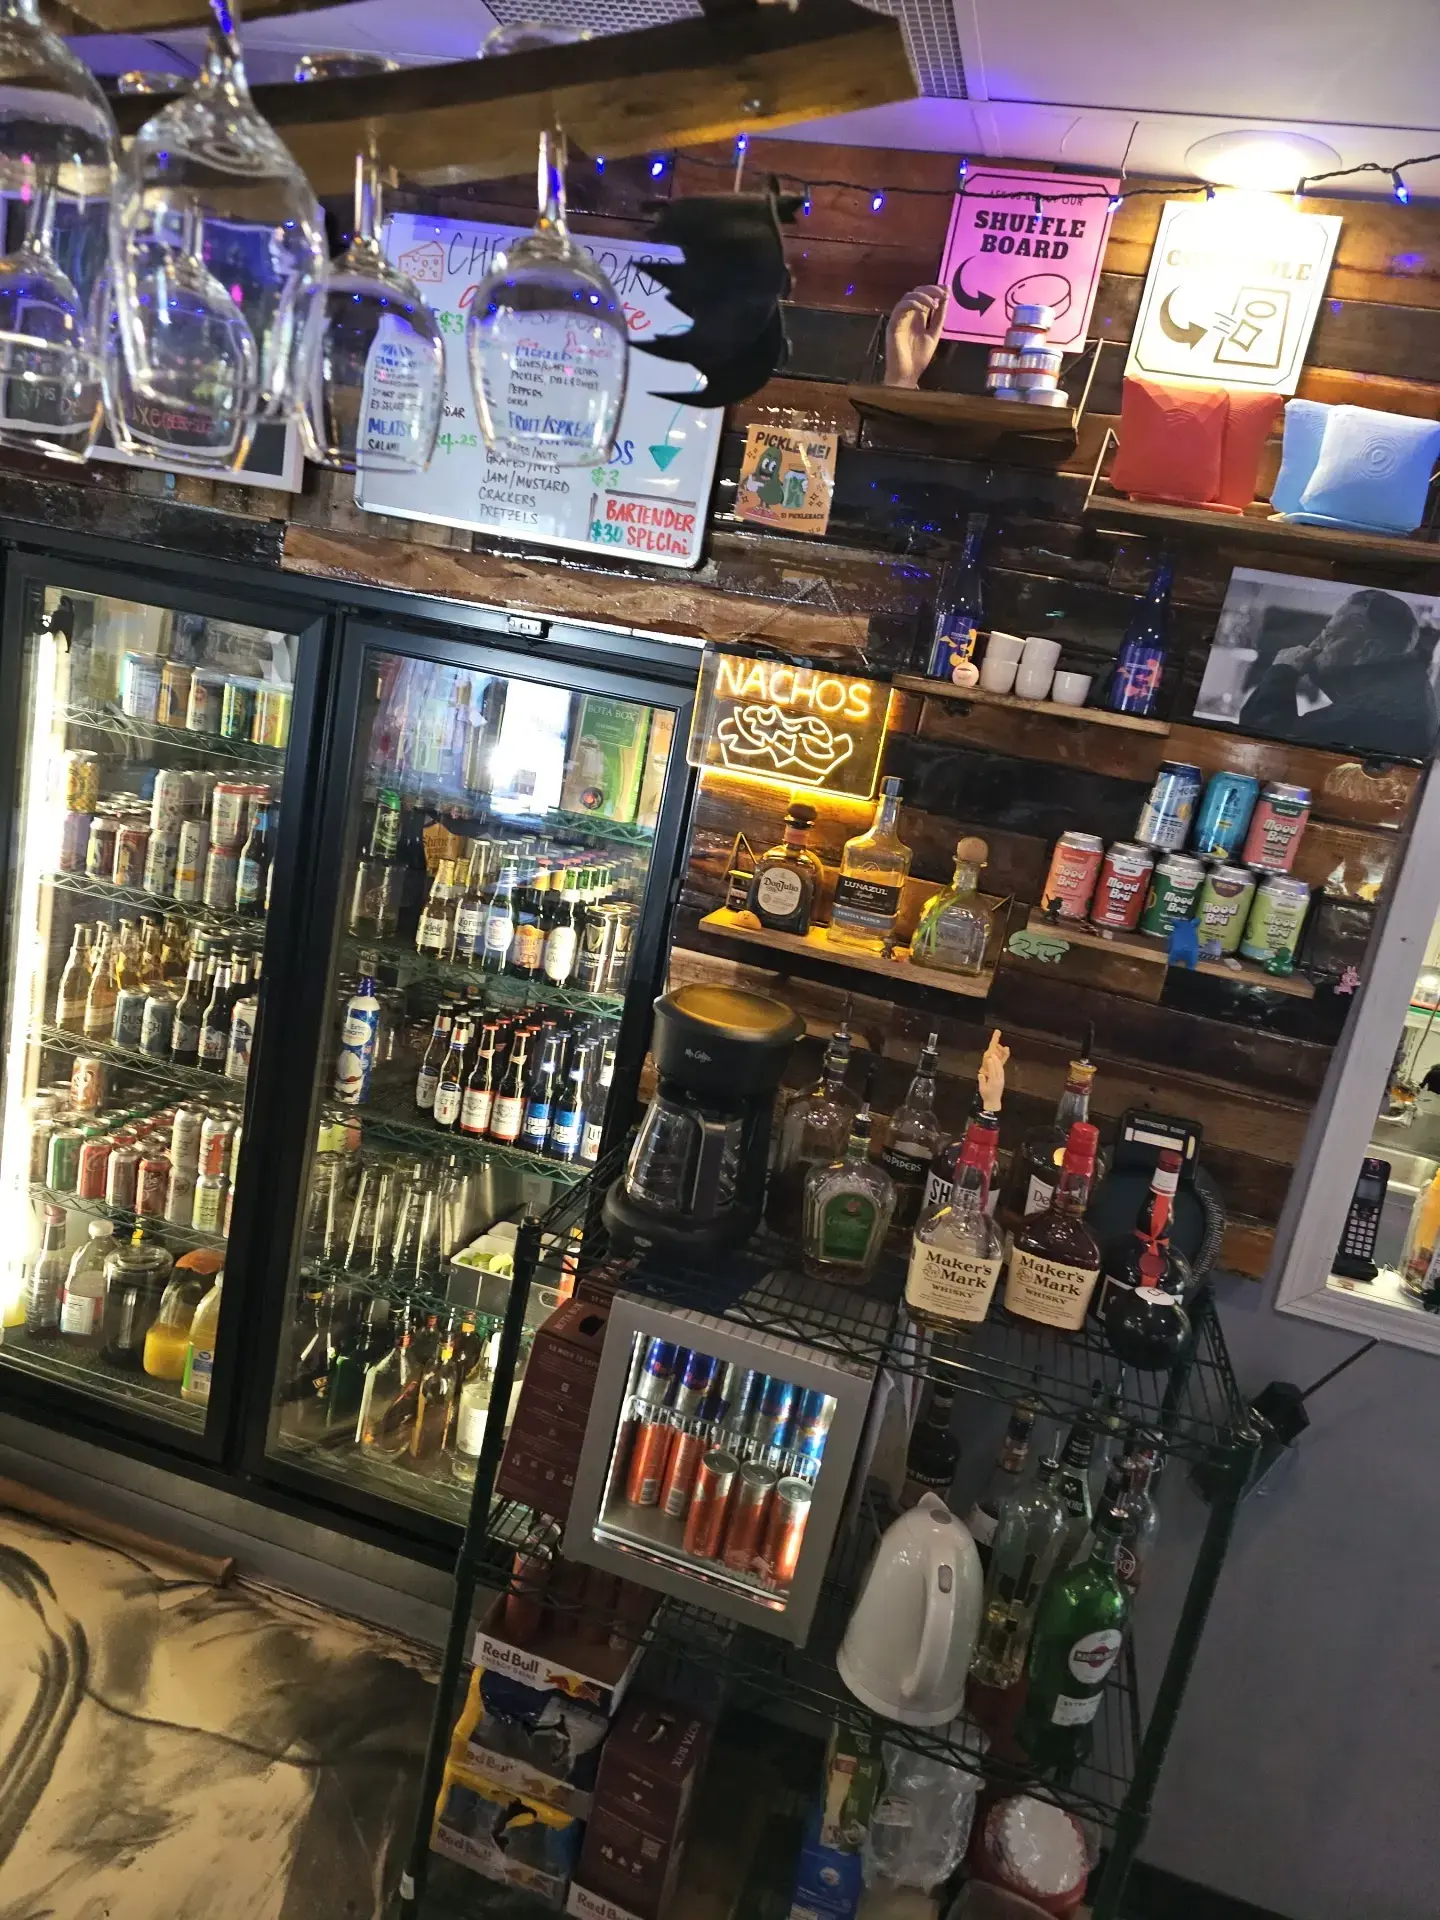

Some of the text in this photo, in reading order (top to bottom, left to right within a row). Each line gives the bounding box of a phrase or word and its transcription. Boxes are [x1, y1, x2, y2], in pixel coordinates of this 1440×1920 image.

[974, 210, 1087, 238] SHUFFLE
[980, 233, 1069, 260] BOARD
[478, 486, 536, 508] CRACKERS
[479, 503, 539, 525] PRETZELS
[606, 499, 696, 534] BARTENDER
[590, 518, 624, 544] $30
[714, 658, 873, 718] NACHOS
[587, 704, 635, 722] BOTA BOX
[1262, 819, 1300, 836] Mood
[1055, 864, 1088, 880] Mood
[843, 880, 889, 896] LUNAZUL
[1106, 876, 1141, 893] Mood
[1109, 887, 1133, 902] Brü
[1163, 891, 1195, 906] Mood
[1202, 901, 1239, 916] Mood
[1264, 912, 1298, 929] Mood
[890, 1158, 923, 1173] PIPERS
[926, 1249, 993, 1276] Maker's
[1018, 1255, 1085, 1284] Maker's
[940, 1268, 988, 1289] Mark
[1033, 1273, 1082, 1297] Mark
[931, 1283, 975, 1299] WHISKY
[1024, 1287, 1068, 1305] WHISKY
[482, 1641, 540, 1674] Red Bull
[577, 1891, 606, 1916] Red
